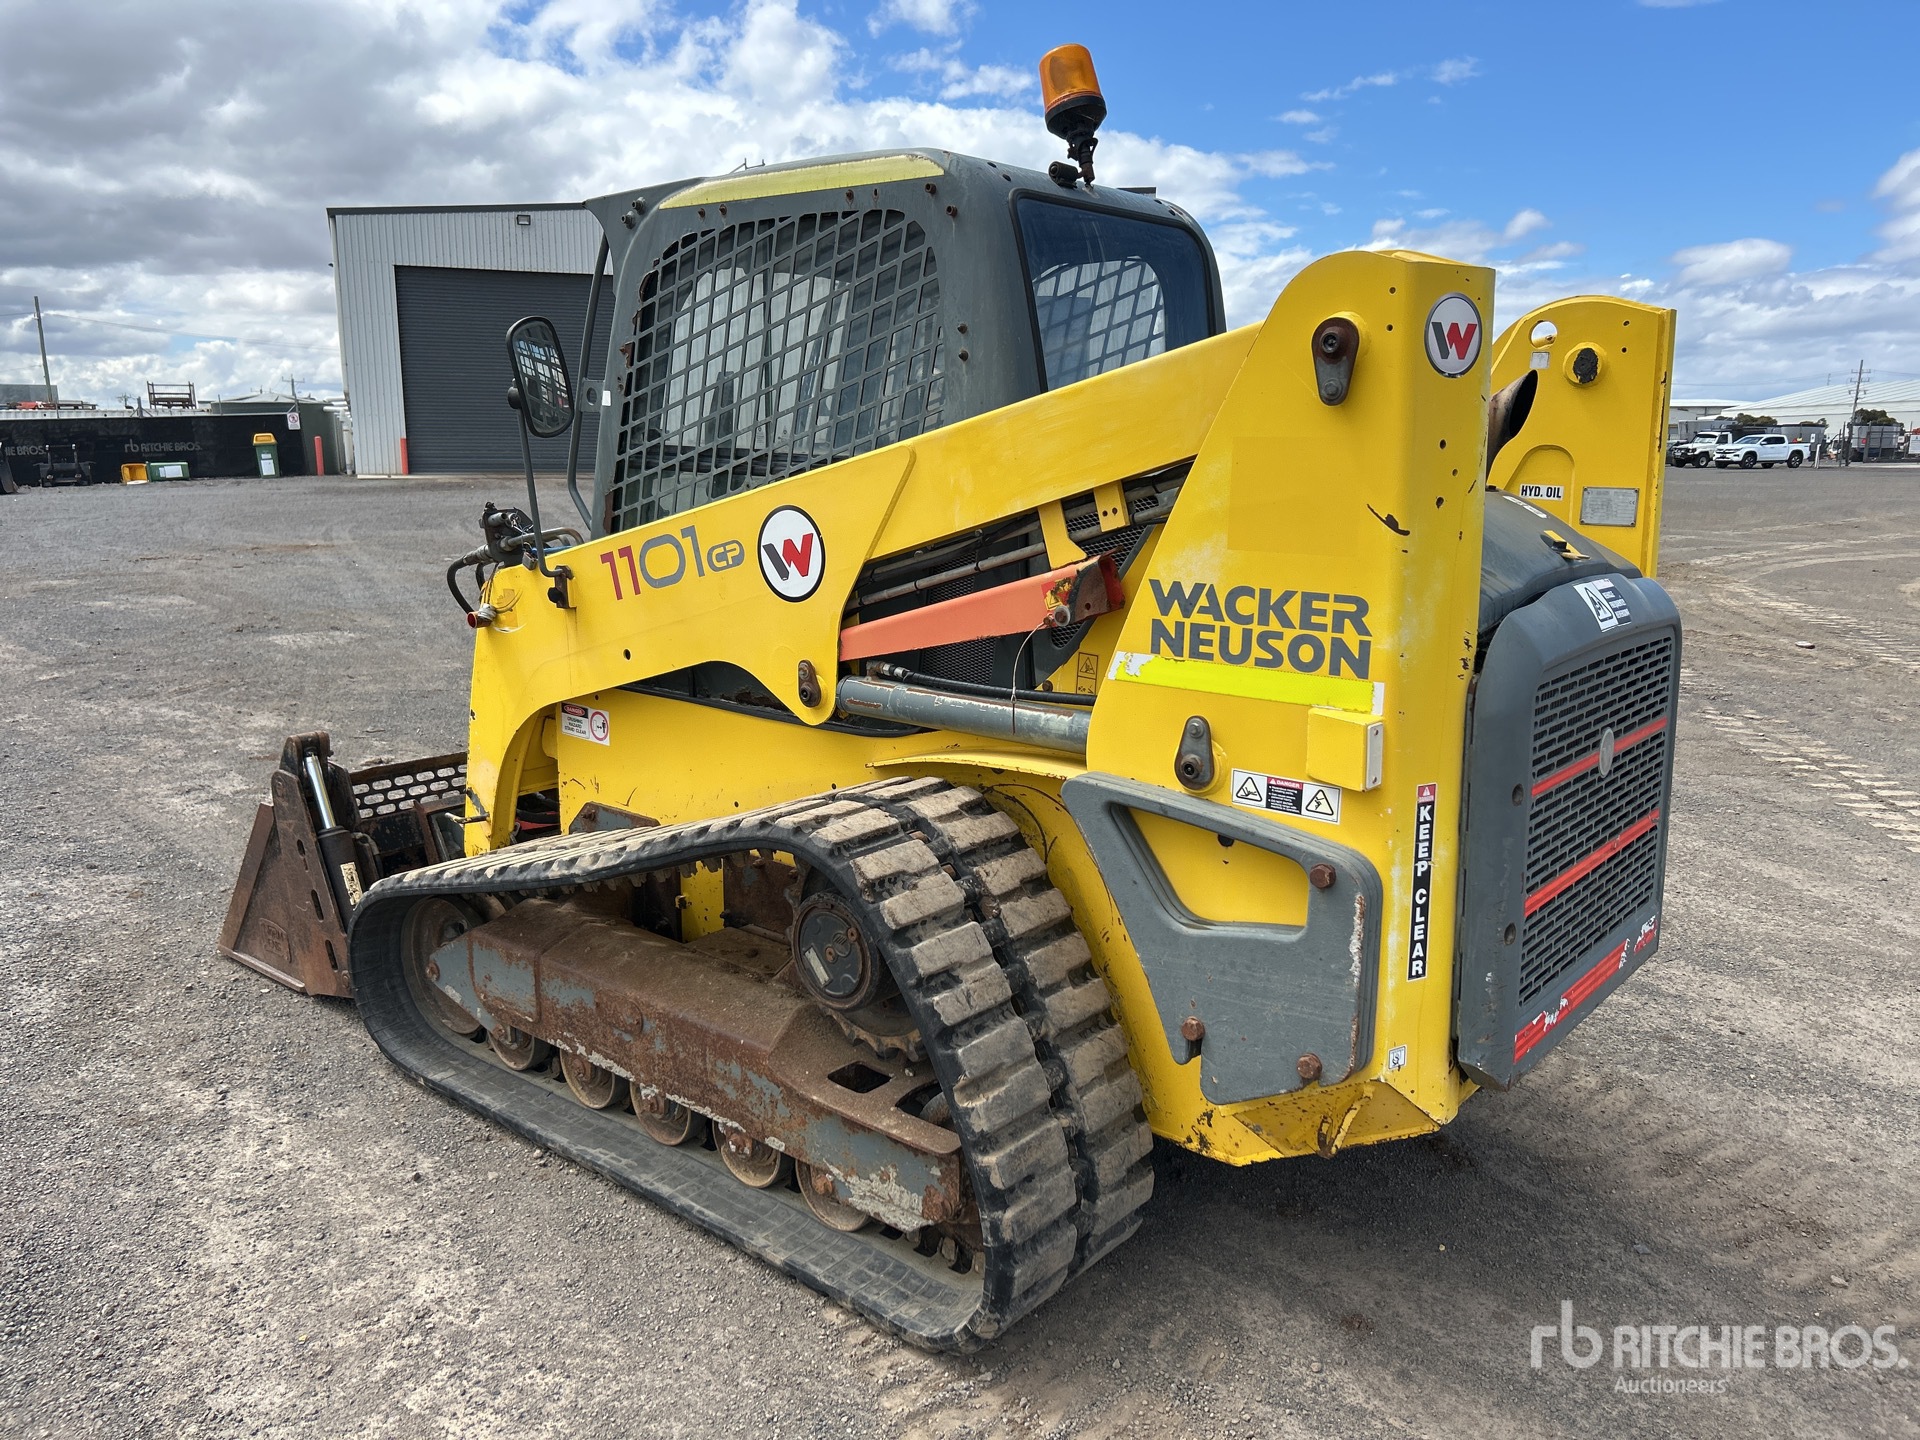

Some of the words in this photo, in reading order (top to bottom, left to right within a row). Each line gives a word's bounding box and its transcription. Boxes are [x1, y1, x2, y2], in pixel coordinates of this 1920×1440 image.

[1520, 484, 1543, 498] HYD.
[1546, 486, 1562, 499] OIL
[600, 525, 705, 601] 1101
[1148, 578, 1373, 638] WACKER
[1150, 618, 1372, 680] NEUSON
[1276, 779, 1300, 789] DANGER
[1416, 805, 1432, 877] KEEP
[1411, 888, 1427, 976] CLEAR
